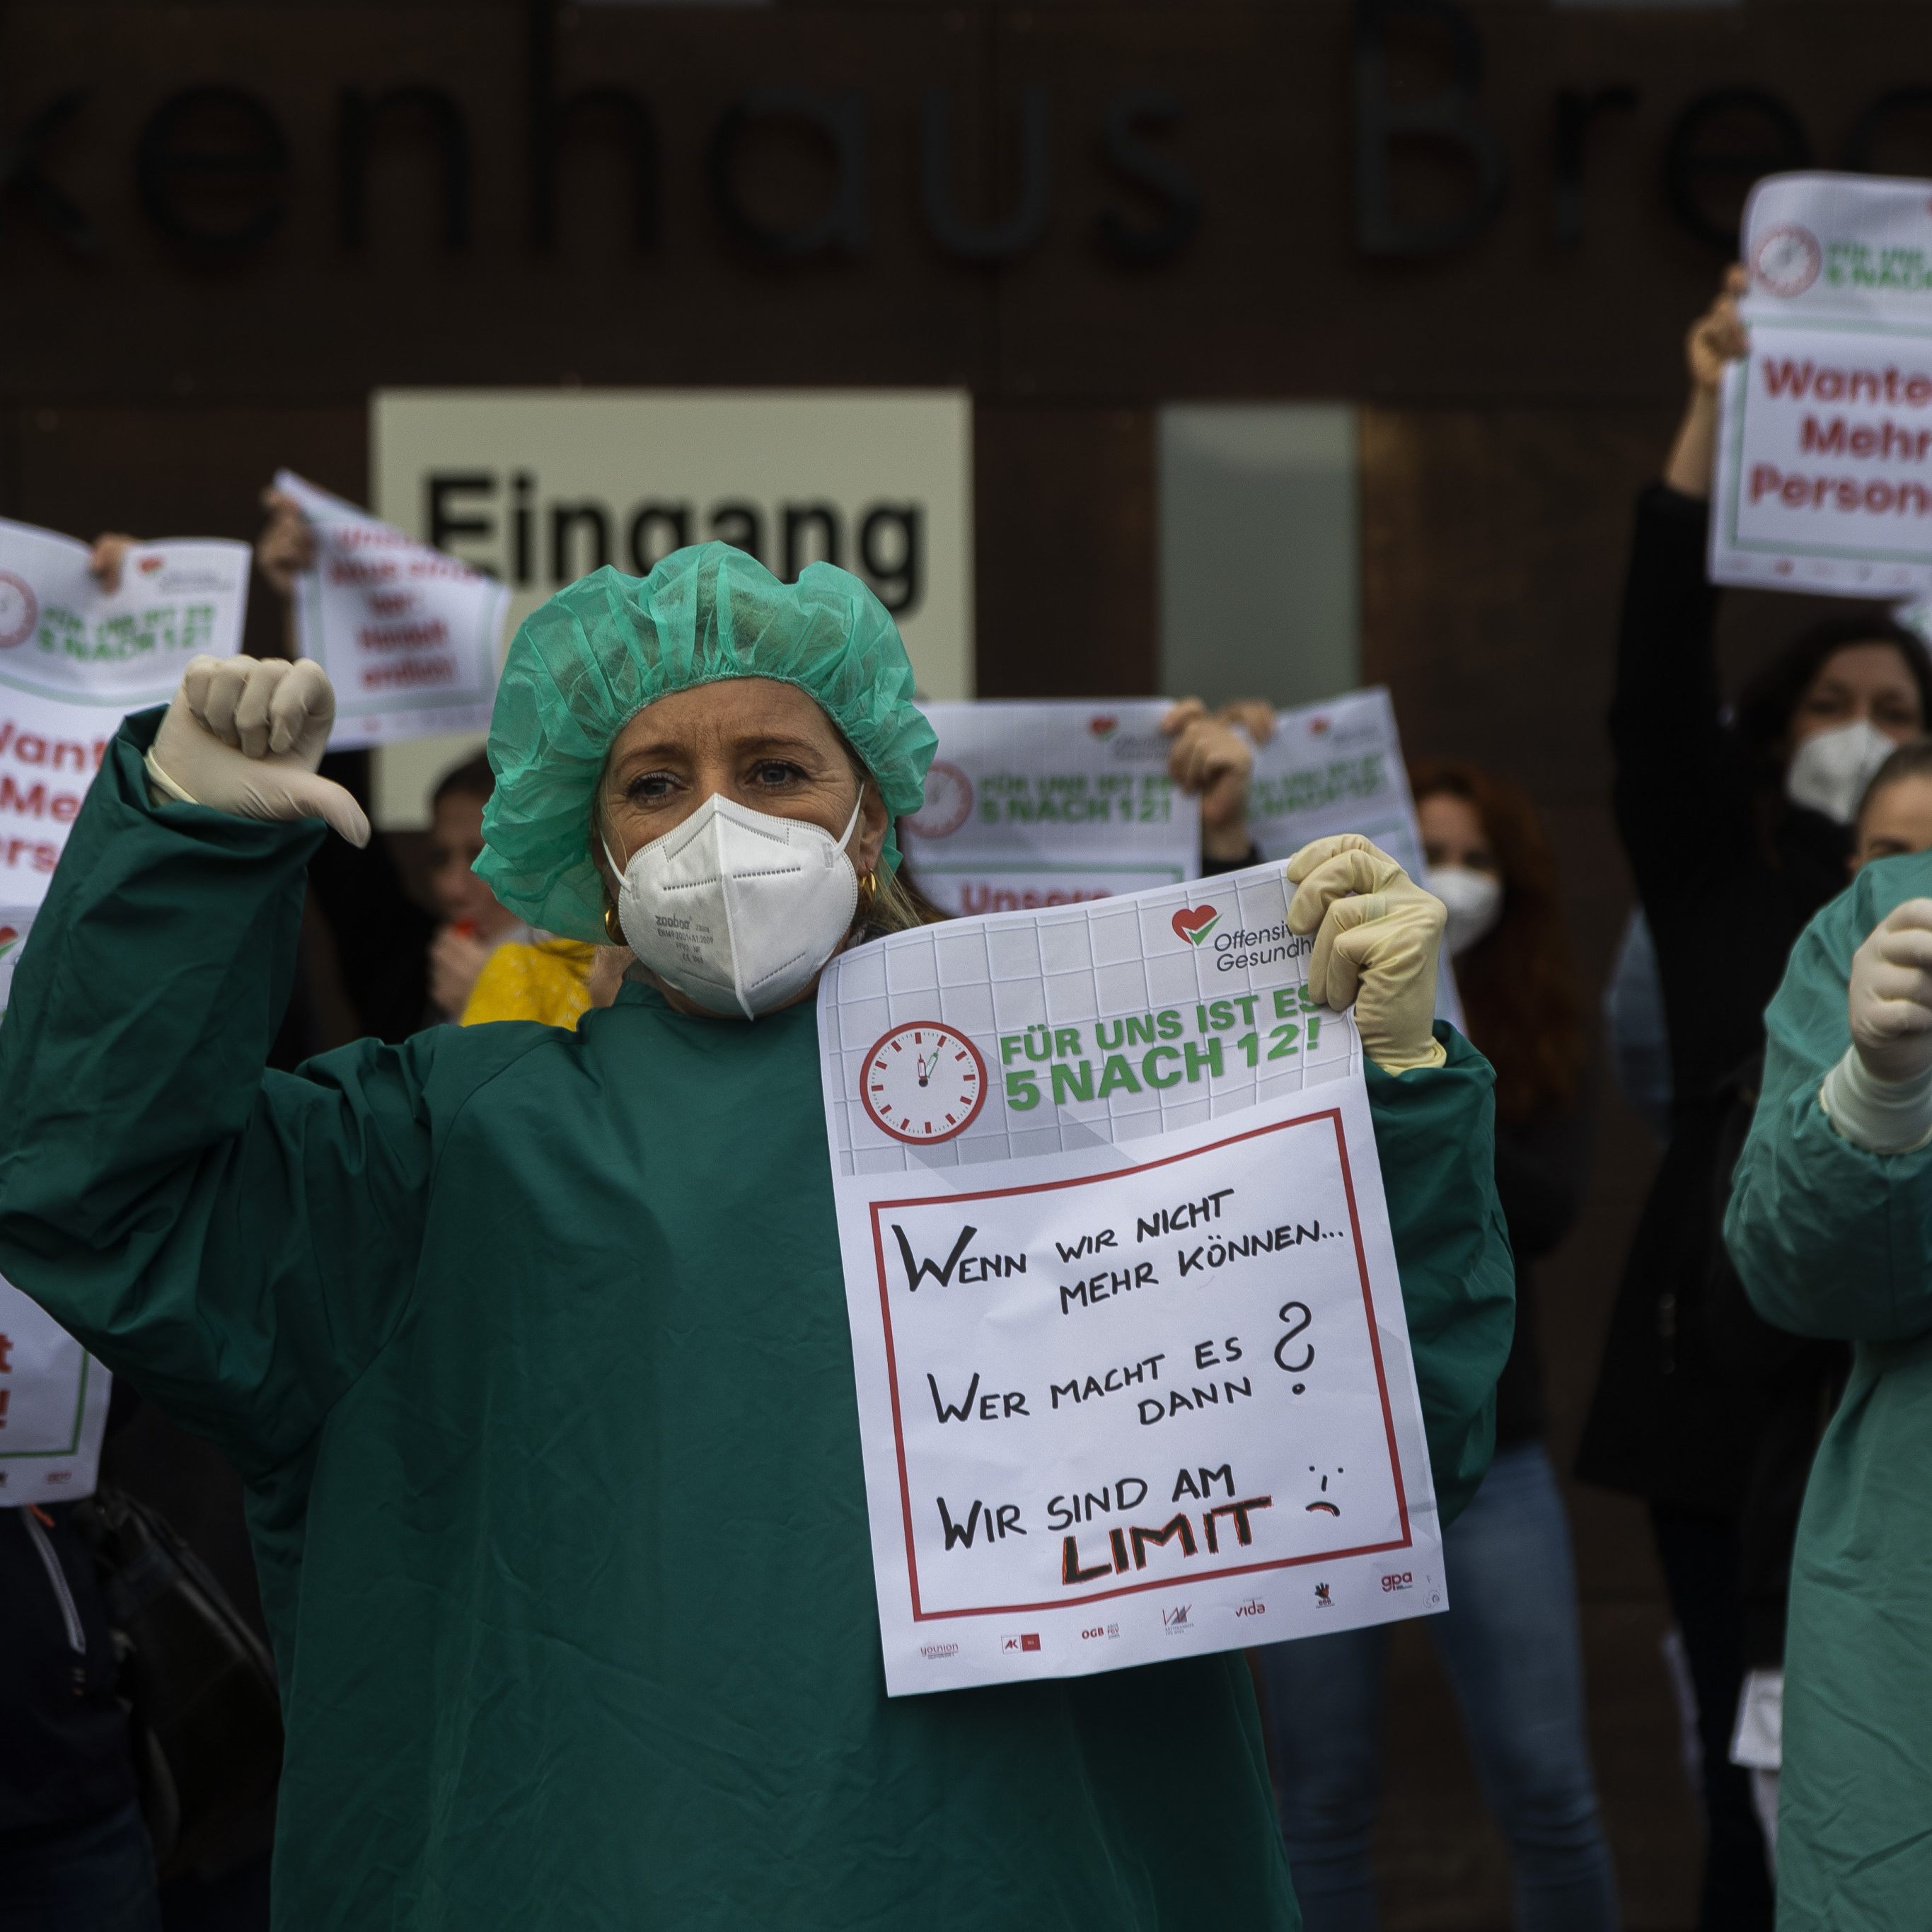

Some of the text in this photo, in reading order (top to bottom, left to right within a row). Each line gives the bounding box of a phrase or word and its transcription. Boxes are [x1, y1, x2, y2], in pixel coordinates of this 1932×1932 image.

[1216, 936, 1316, 972] Gesundh
[1000, 983, 1321, 1066] FÜR UNS IST ES
[1006, 1017, 1321, 1111] 5 NACH 12!
[1055, 1229, 1118, 1263] WIR
[1136, 1188, 1235, 1243] NICHT
[1059, 1220, 1344, 1314] MEHR KÖNNEN...
[927, 1372, 1030, 1423] WER
[1050, 1354, 1165, 1409] MACHT
[1194, 1337, 1244, 1370] ES
[1137, 1376, 1252, 1425] DANN
[937, 1464, 1237, 1551] WIR SIND AM
[1061, 1496, 1272, 1586] LIMIT
[1236, 1599, 1265, 1617] vida
[1382, 1572, 1413, 1592] gpa
[1005, 1638, 1019, 1650] AK
